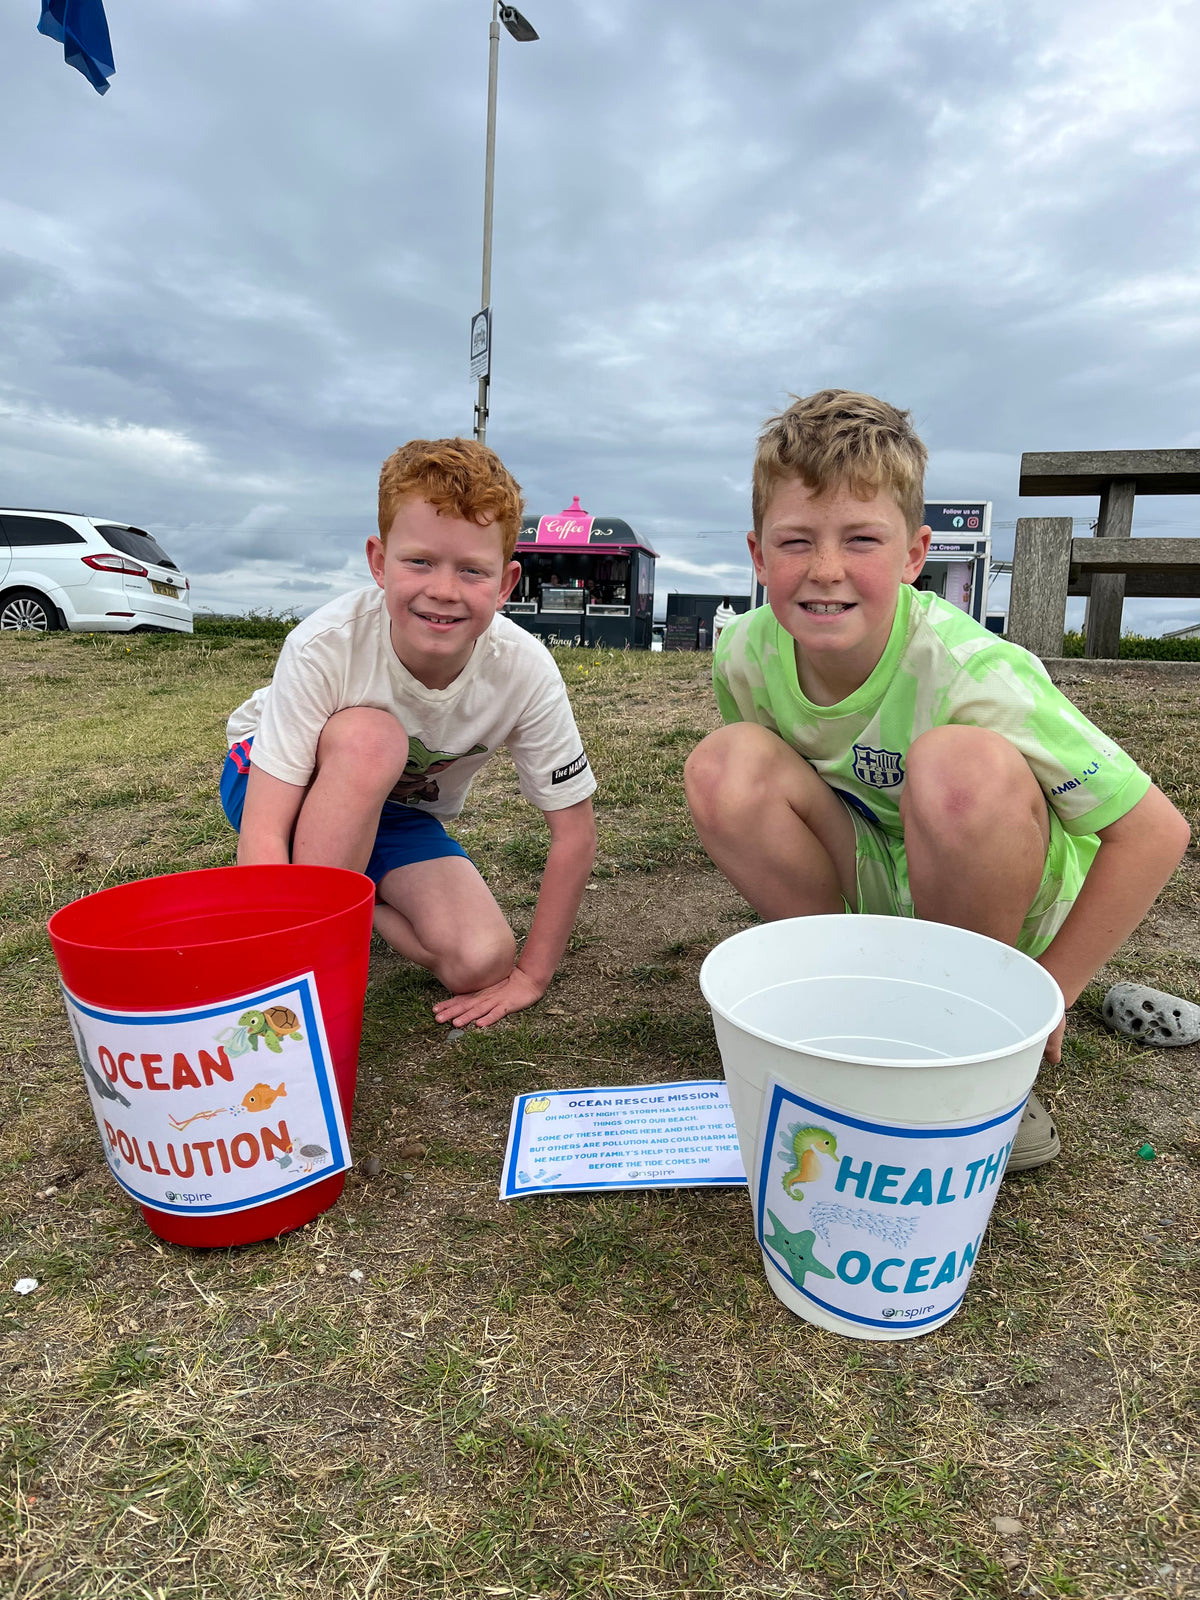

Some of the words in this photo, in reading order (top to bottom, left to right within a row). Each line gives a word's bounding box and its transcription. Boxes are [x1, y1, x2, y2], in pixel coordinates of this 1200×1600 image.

[545, 520, 584, 540] Coffee
[548, 634, 572, 647] Fancy
[98, 1045, 234, 1091] OCEAN
[569, 1100, 612, 1108] OCEAN
[615, 1096, 664, 1105] RESCUE
[668, 1092, 719, 1102] MISSION
[104, 1118, 293, 1178] POLLUTION
[834, 1134, 1017, 1206] HEALTHY
[836, 1233, 981, 1294] OCEAN
